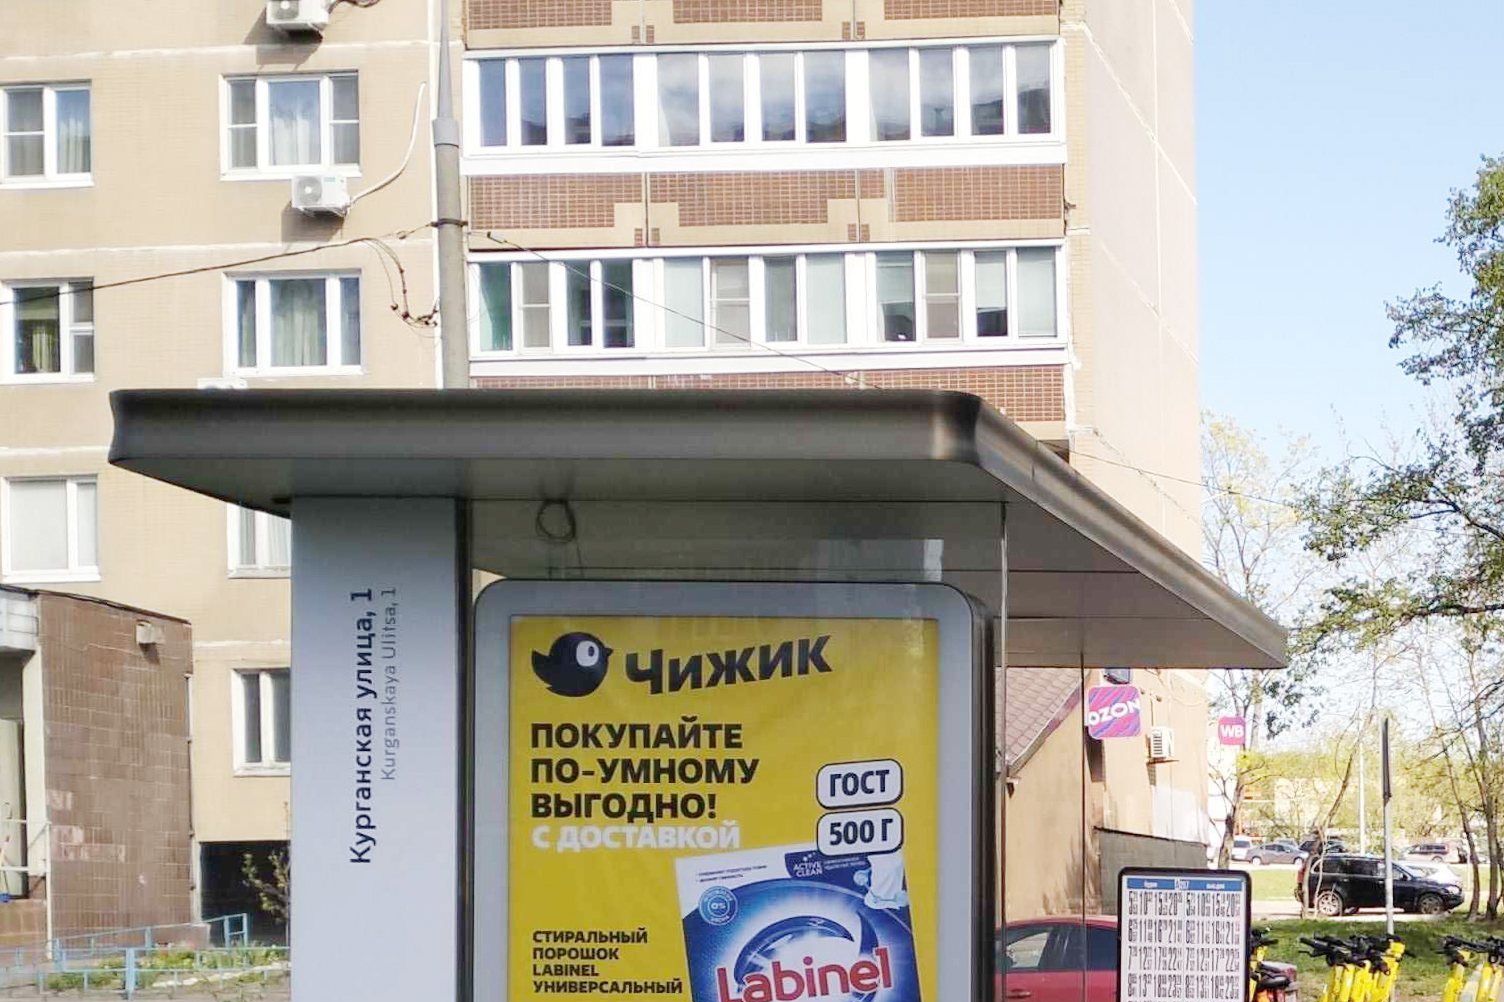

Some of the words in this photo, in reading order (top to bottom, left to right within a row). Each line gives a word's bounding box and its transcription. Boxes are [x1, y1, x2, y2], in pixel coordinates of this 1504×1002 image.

[351, 588, 372, 601] 1
[381, 587, 396, 596] 1
[381, 601, 399, 659] Ulitsa,
[356, 611, 377, 699] улица,
[381, 665, 400, 780] Kurganskaya
[1087, 699, 1140, 726] OZON
[531, 716, 742, 750] ПОКУПАЙТЕ
[1220, 724, 1244, 738] WB
[531, 758, 759, 784] ПО-УМНОМУ
[829, 769, 890, 798] ГОСТ
[350, 707, 377, 863] Курганская
[531, 793, 717, 824] ВЫГОДНО!
[532, 827, 550, 849] С
[557, 821, 740, 852] ДОСТАВКОЙ
[829, 820, 875, 846] 500
[793, 861, 821, 871] ACTIVE
[796, 868, 823, 878] CLEAN
[532, 928, 648, 944] СТИРАЛЬНЫЙ
[532, 947, 619, 961] ПОРОШОК
[532, 964, 599, 977] LABINEL
[532, 978, 683, 995] УНИВЕРСАЛЬНЫЙ
